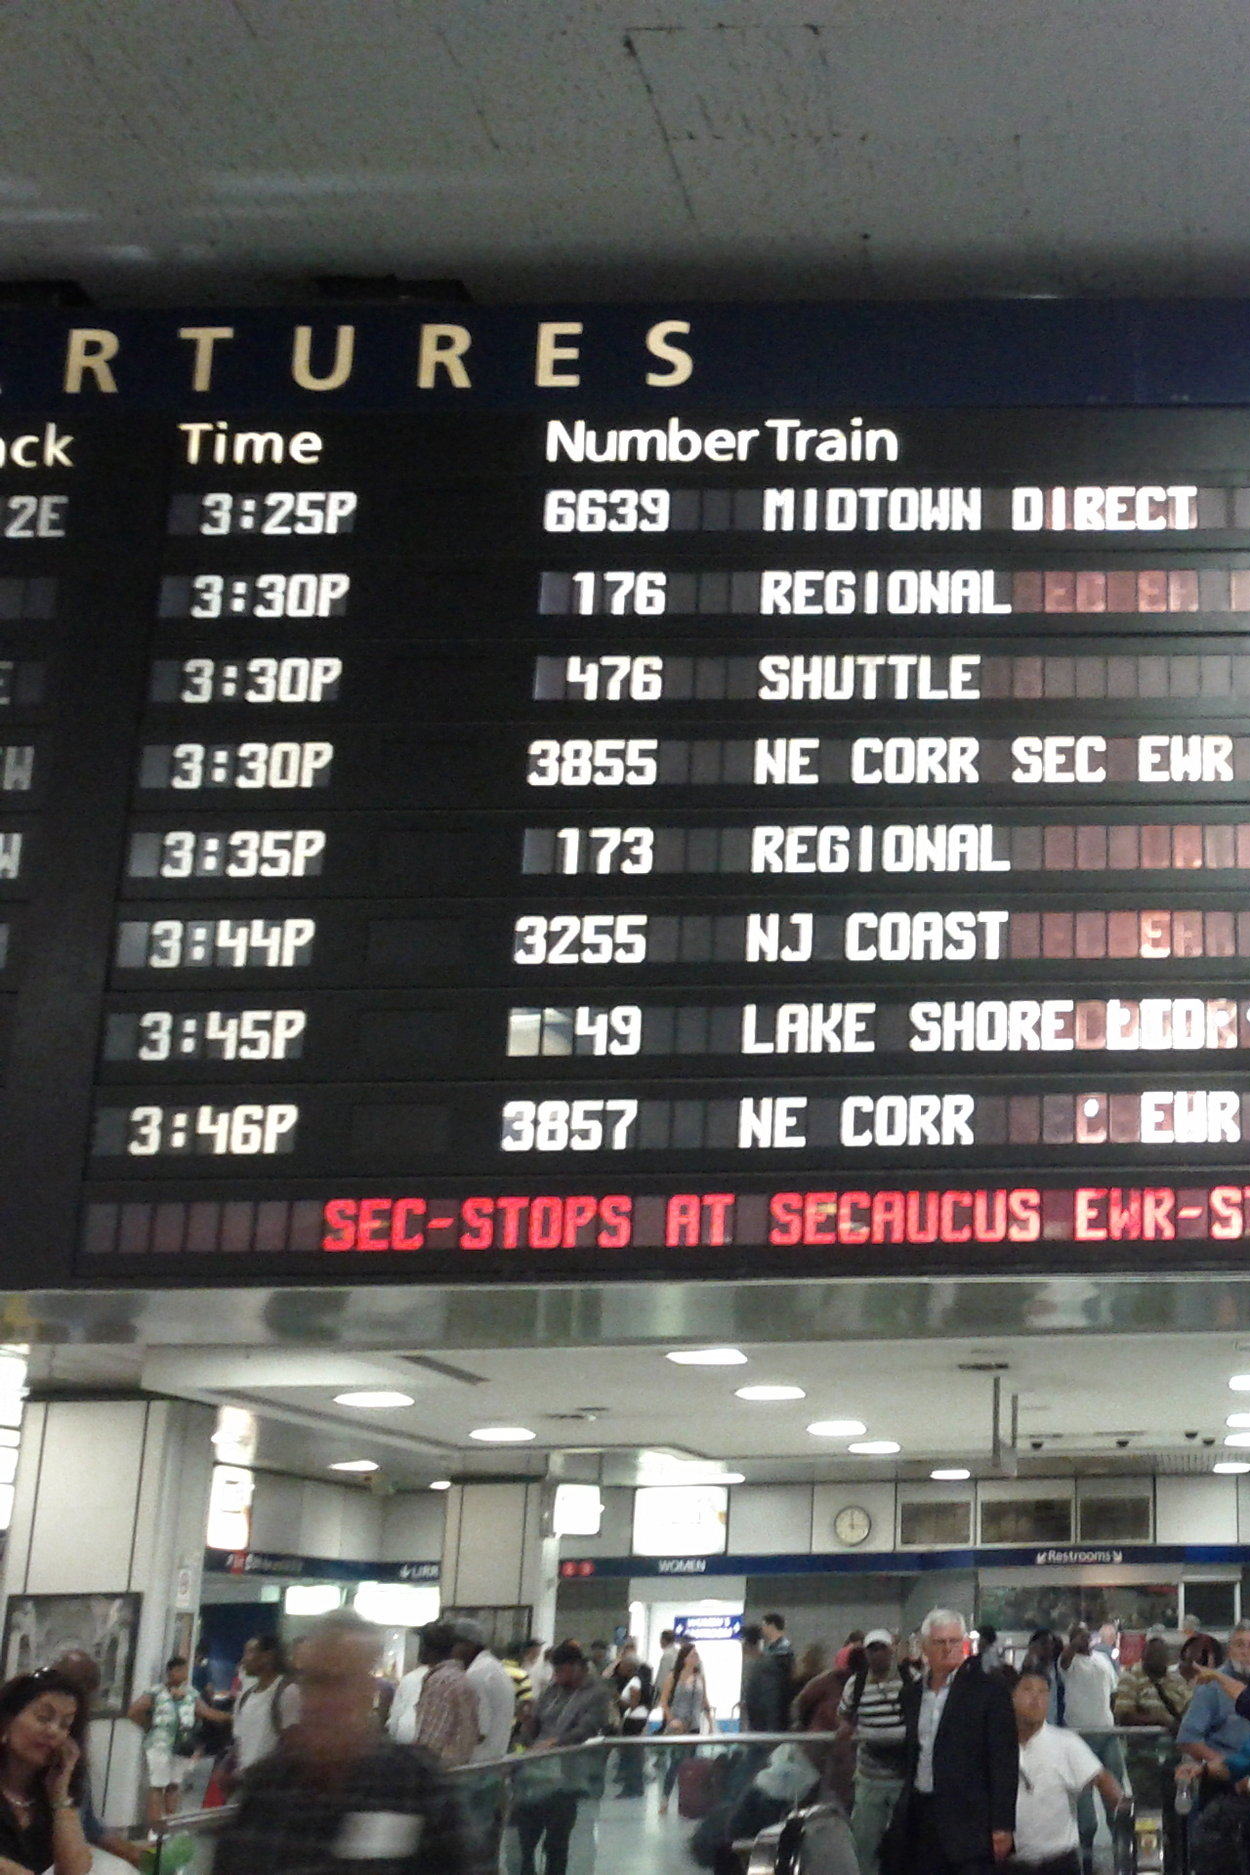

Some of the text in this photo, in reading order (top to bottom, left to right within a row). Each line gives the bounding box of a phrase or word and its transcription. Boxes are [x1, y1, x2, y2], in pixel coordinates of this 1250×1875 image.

[0, 421, 75, 468] ck
[178, 422, 324, 466] Time
[545, 419, 759, 463] Number
[764, 417, 899, 463] Train
[200, 491, 358, 536] 3:25P
[543, 489, 670, 534] 6639
[762, 486, 1198, 531] MIDTOWN DIRECT
[190, 573, 350, 619] 3:30P
[572, 571, 667, 616] 176
[759, 570, 1012, 615] REGIONAL
[180, 656, 343, 703] 3:30P
[565, 655, 662, 701] 476
[757, 655, 982, 700] SHUTTLE
[171, 741, 333, 786] 3:30P
[527, 739, 659, 786] 3855
[754, 734, 1234, 785] NE CORR SEC EWR
[161, 830, 326, 878] 3:35P
[554, 828, 654, 875] 173
[751, 824, 1012, 873] REGIONAL
[149, 919, 316, 968] 3:44P
[514, 915, 648, 965] 3255
[745, 911, 1010, 962] NJ COAST
[138, 1010, 307, 1061] 3:45P
[574, 1006, 642, 1056] 49
[742, 1003, 876, 1054] LAKE
[908, 999, 1075, 1053] SHORE
[128, 1104, 300, 1156] 3:46P
[501, 1100, 638, 1151] 3857
[738, 1091, 1241, 1148] NE CORR EWR
[322, 1198, 631, 1252] SEC-STOPS
[665, 1194, 736, 1248] AT
[770, 1187, 1042, 1245] SECAUCUS
[657, 1558, 707, 1574] WOMEN
[1048, 1549, 1112, 1563] Restrooms
